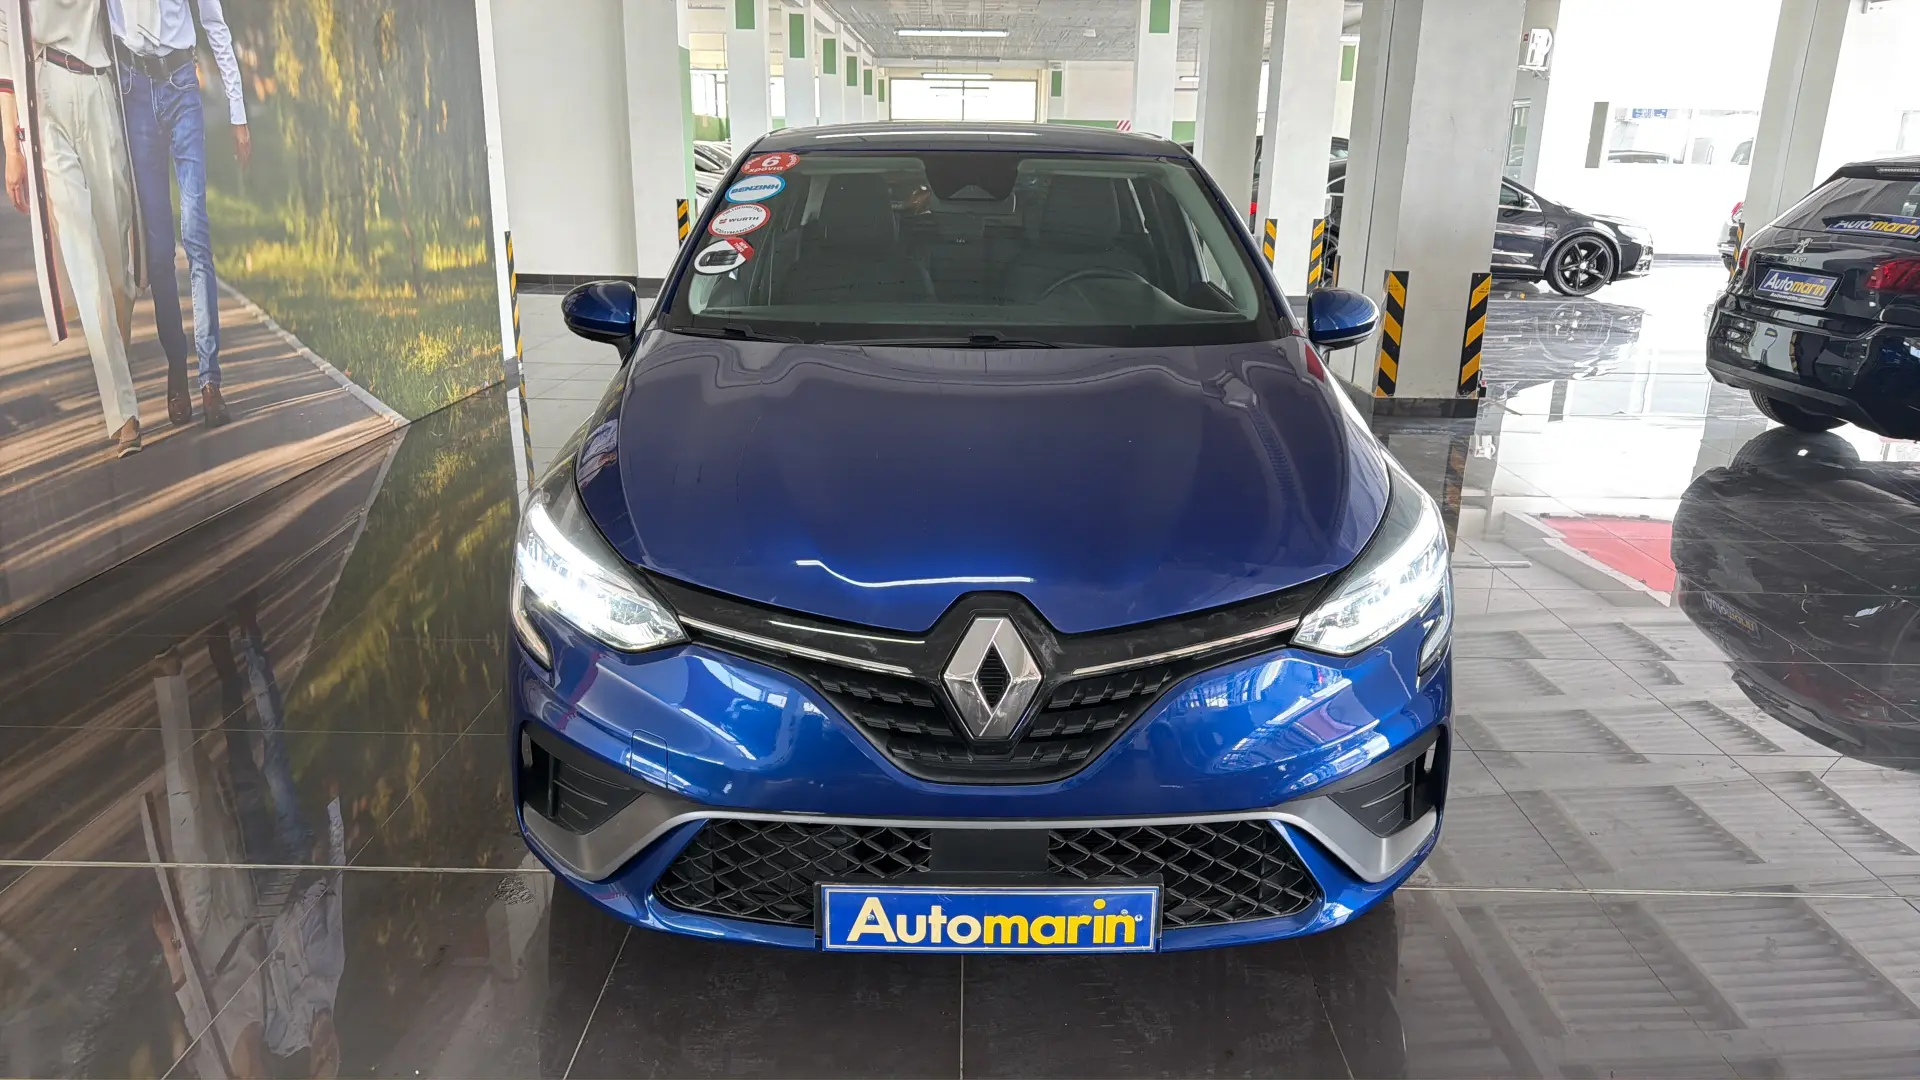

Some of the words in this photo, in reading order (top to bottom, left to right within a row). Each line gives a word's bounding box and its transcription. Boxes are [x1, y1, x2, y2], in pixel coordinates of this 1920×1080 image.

[762, 155, 782, 167] 6
[1764, 272, 1827, 297] Automarin
[846, 896, 1136, 945] Automarin
